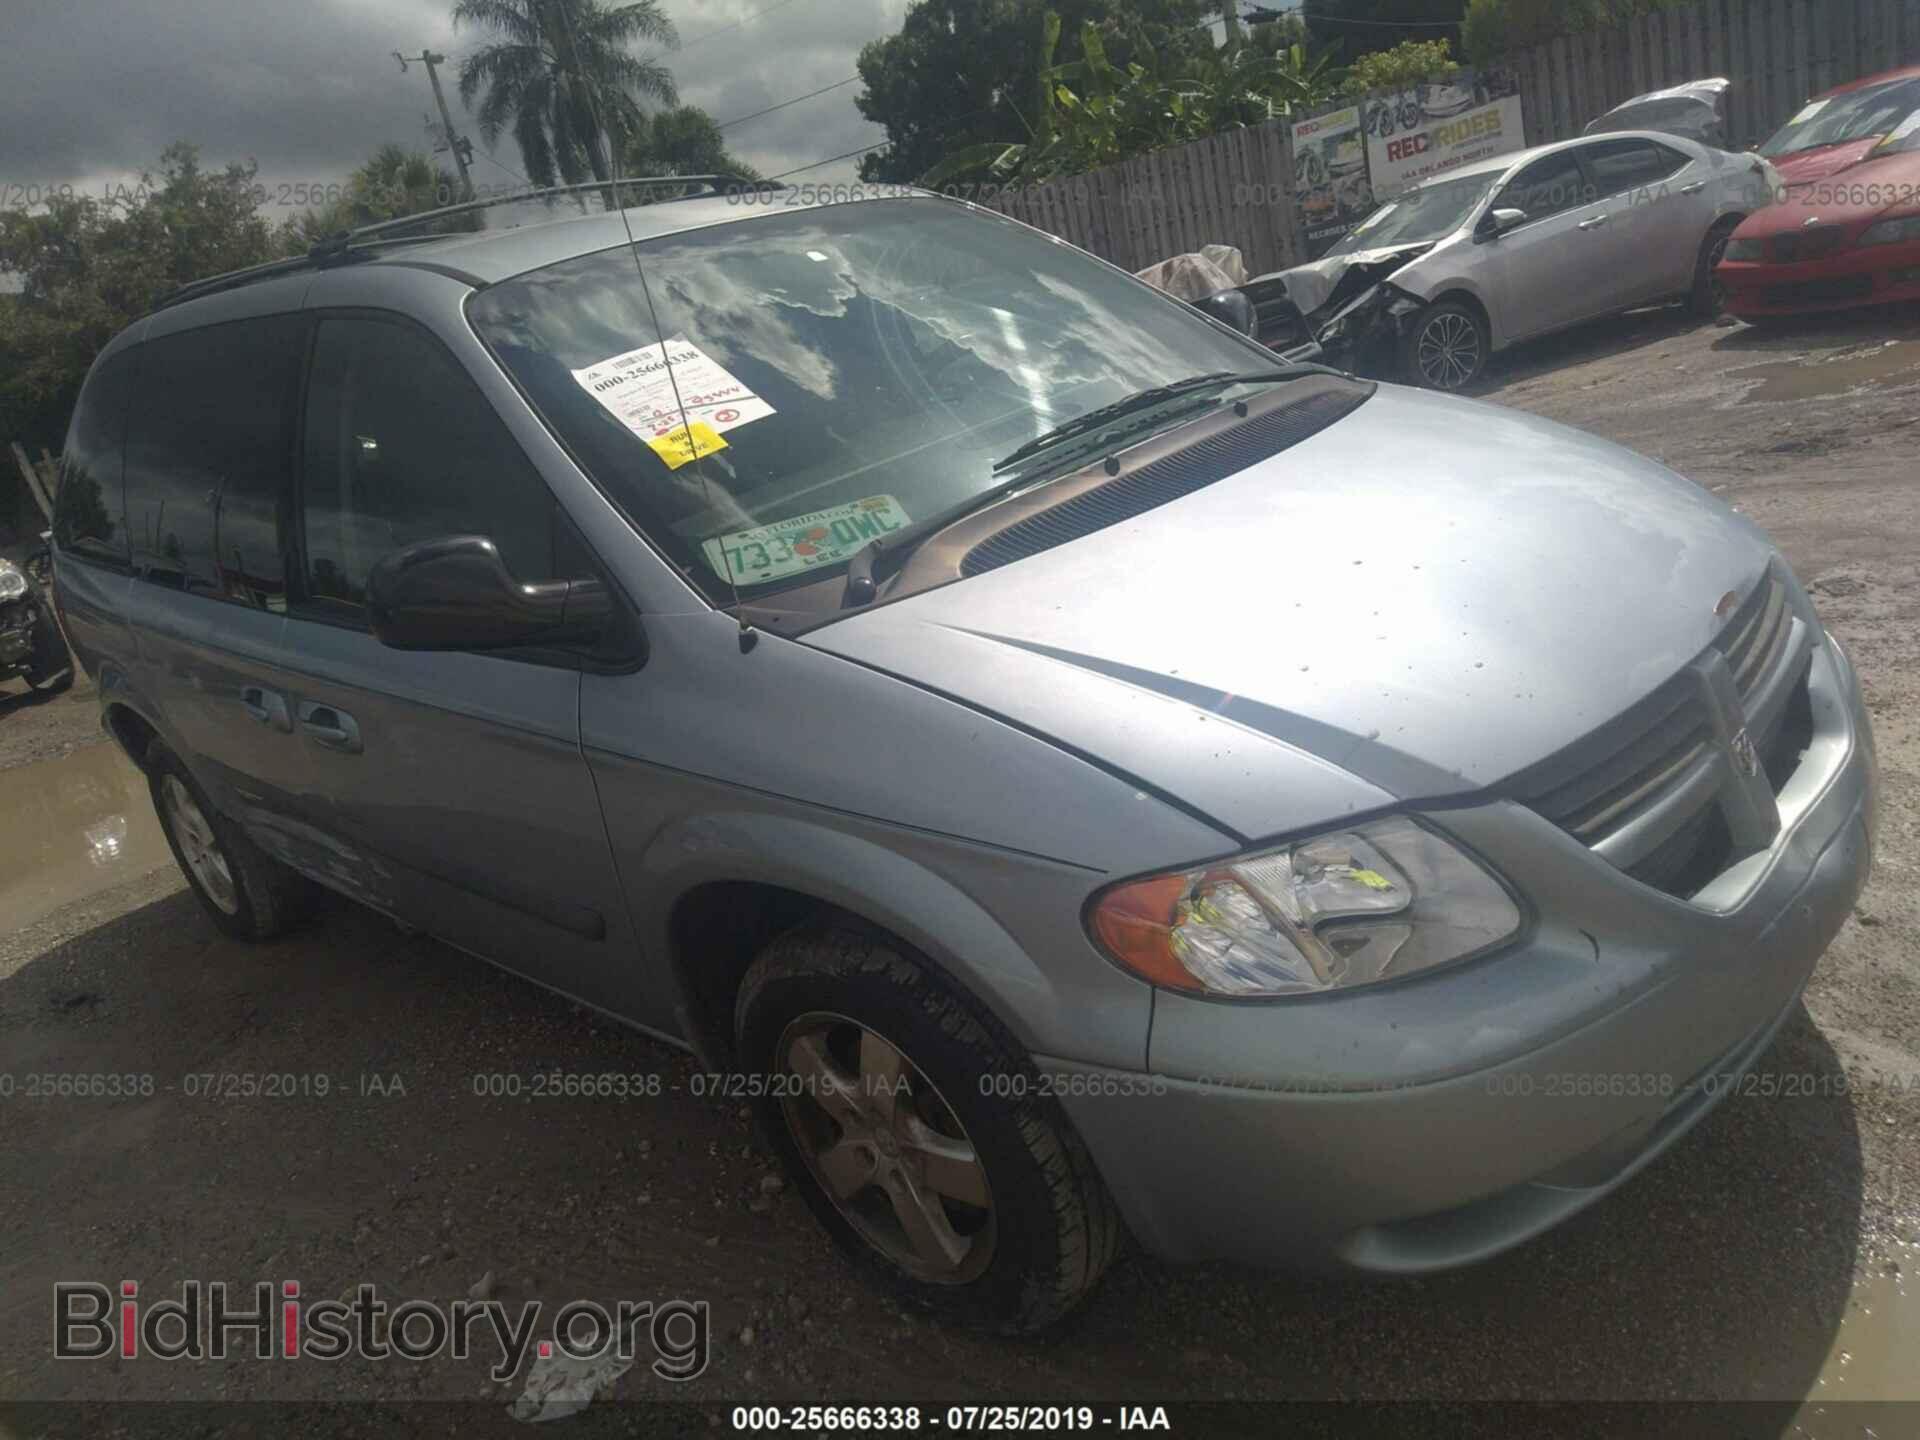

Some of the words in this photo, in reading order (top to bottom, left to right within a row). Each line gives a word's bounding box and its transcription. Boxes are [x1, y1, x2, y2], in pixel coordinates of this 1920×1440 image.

[1387, 131, 1429, 162] REC
[594, 350, 699, 393] 000-25666338
[725, 537, 794, 574] 733
